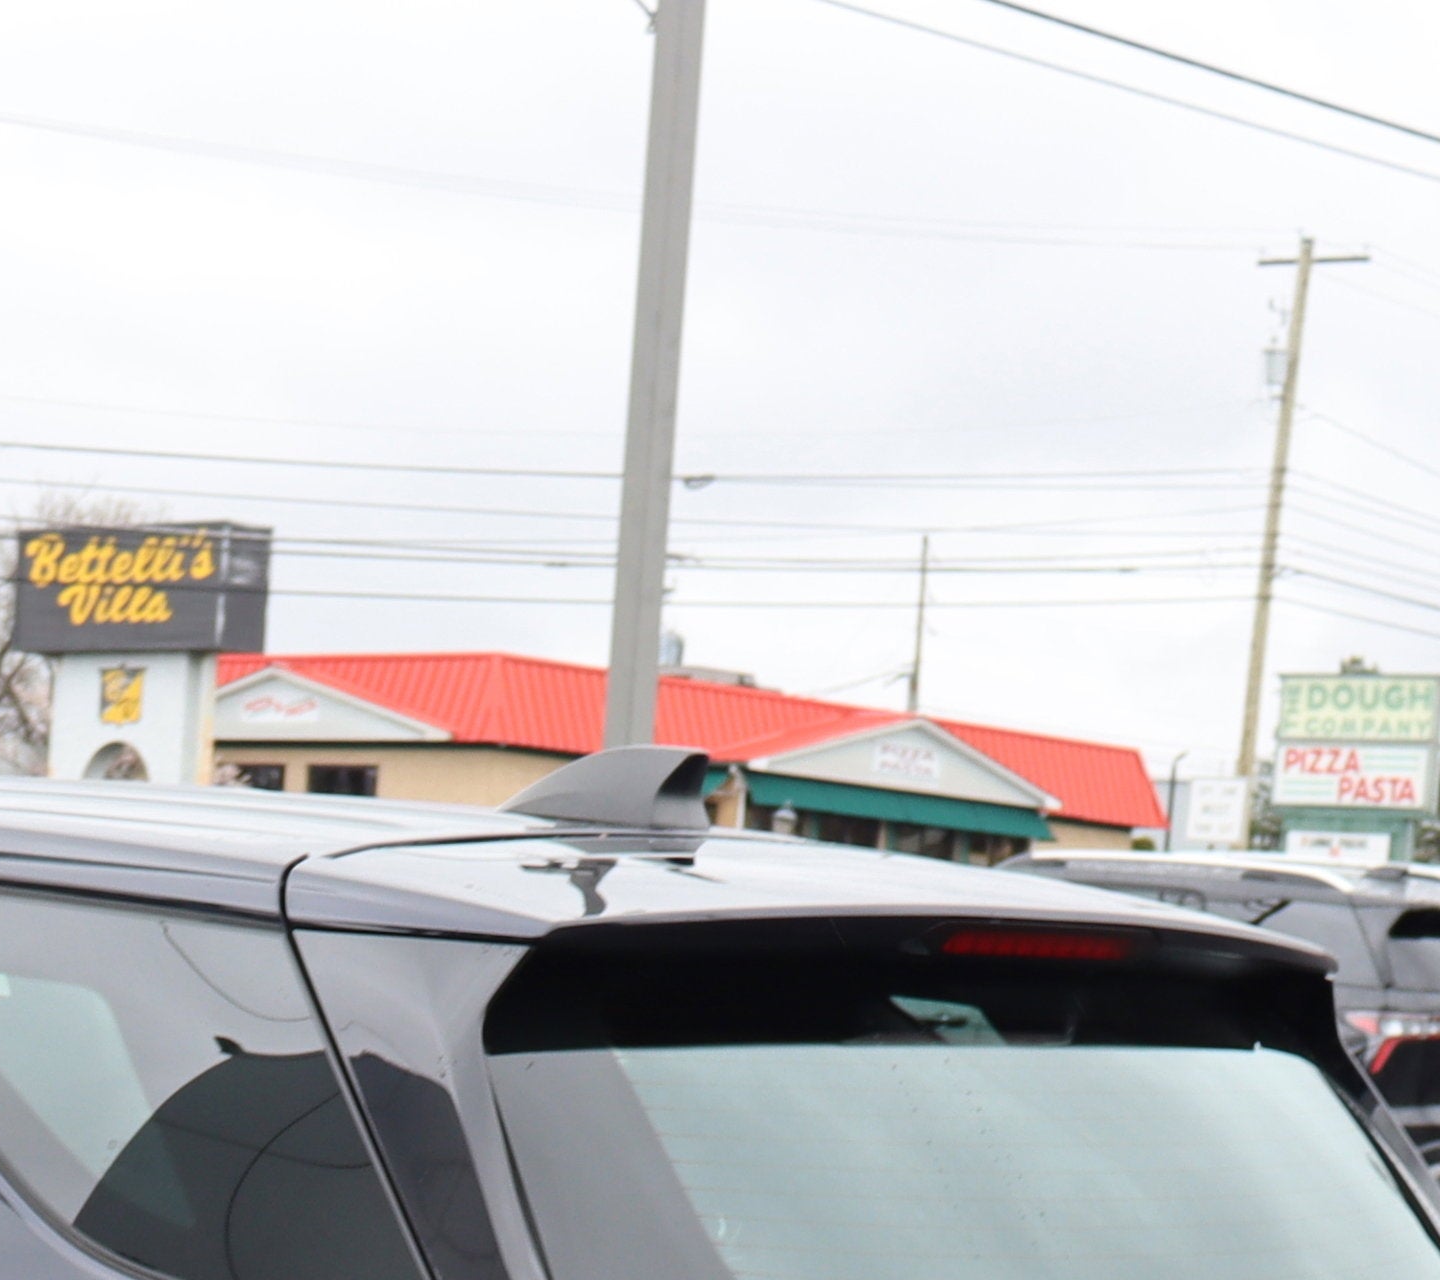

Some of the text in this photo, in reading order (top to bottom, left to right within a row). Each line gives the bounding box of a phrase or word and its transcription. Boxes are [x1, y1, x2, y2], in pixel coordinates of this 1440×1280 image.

[57, 584, 173, 626] Villa
[1307, 683, 1432, 711] DOUGH
[1305, 716, 1430, 736] COMPANY
[1284, 747, 1361, 775] PIZZA
[1337, 775, 1417, 804] PASTA
